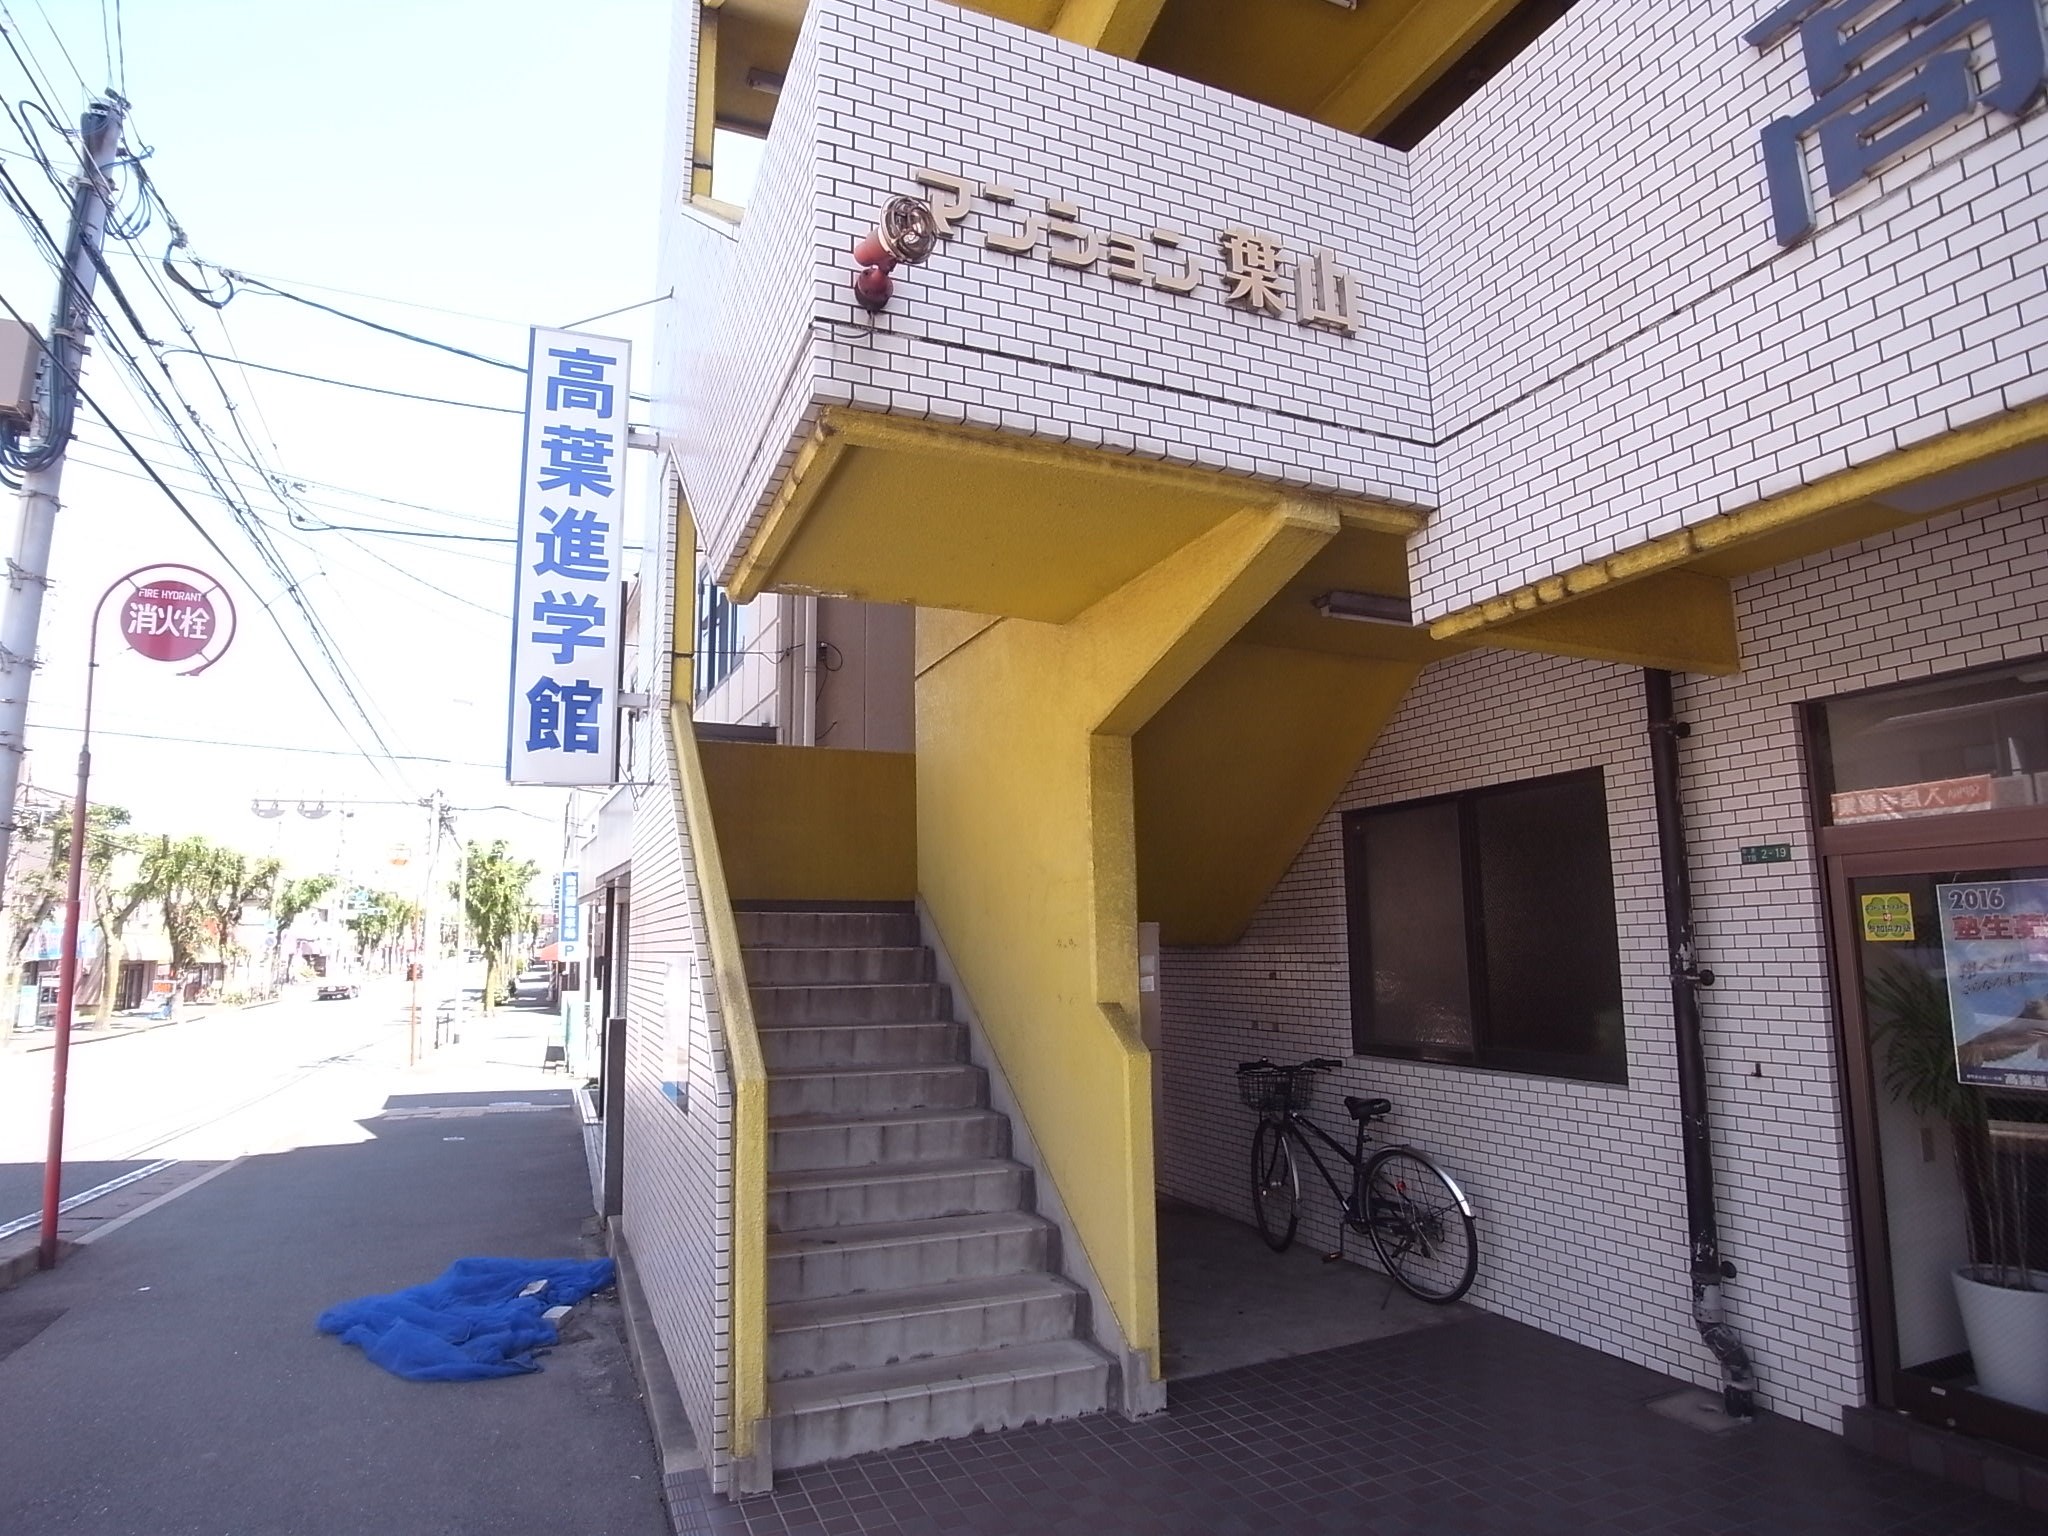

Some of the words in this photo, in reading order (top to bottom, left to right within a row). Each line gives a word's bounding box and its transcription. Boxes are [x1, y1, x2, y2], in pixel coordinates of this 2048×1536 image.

[914, 168, 1359, 338] マンション葉山
[525, 348, 617, 754] 高葉進学館
[138, 588, 159, 599] FIRE
[161, 590, 202, 602] HYDRANT
[128, 602, 210, 640] 消火栓
[1761, 847, 1787, 859] 2-19
[1949, 888, 2005, 910] 2016
[564, 945, 575, 957] P
